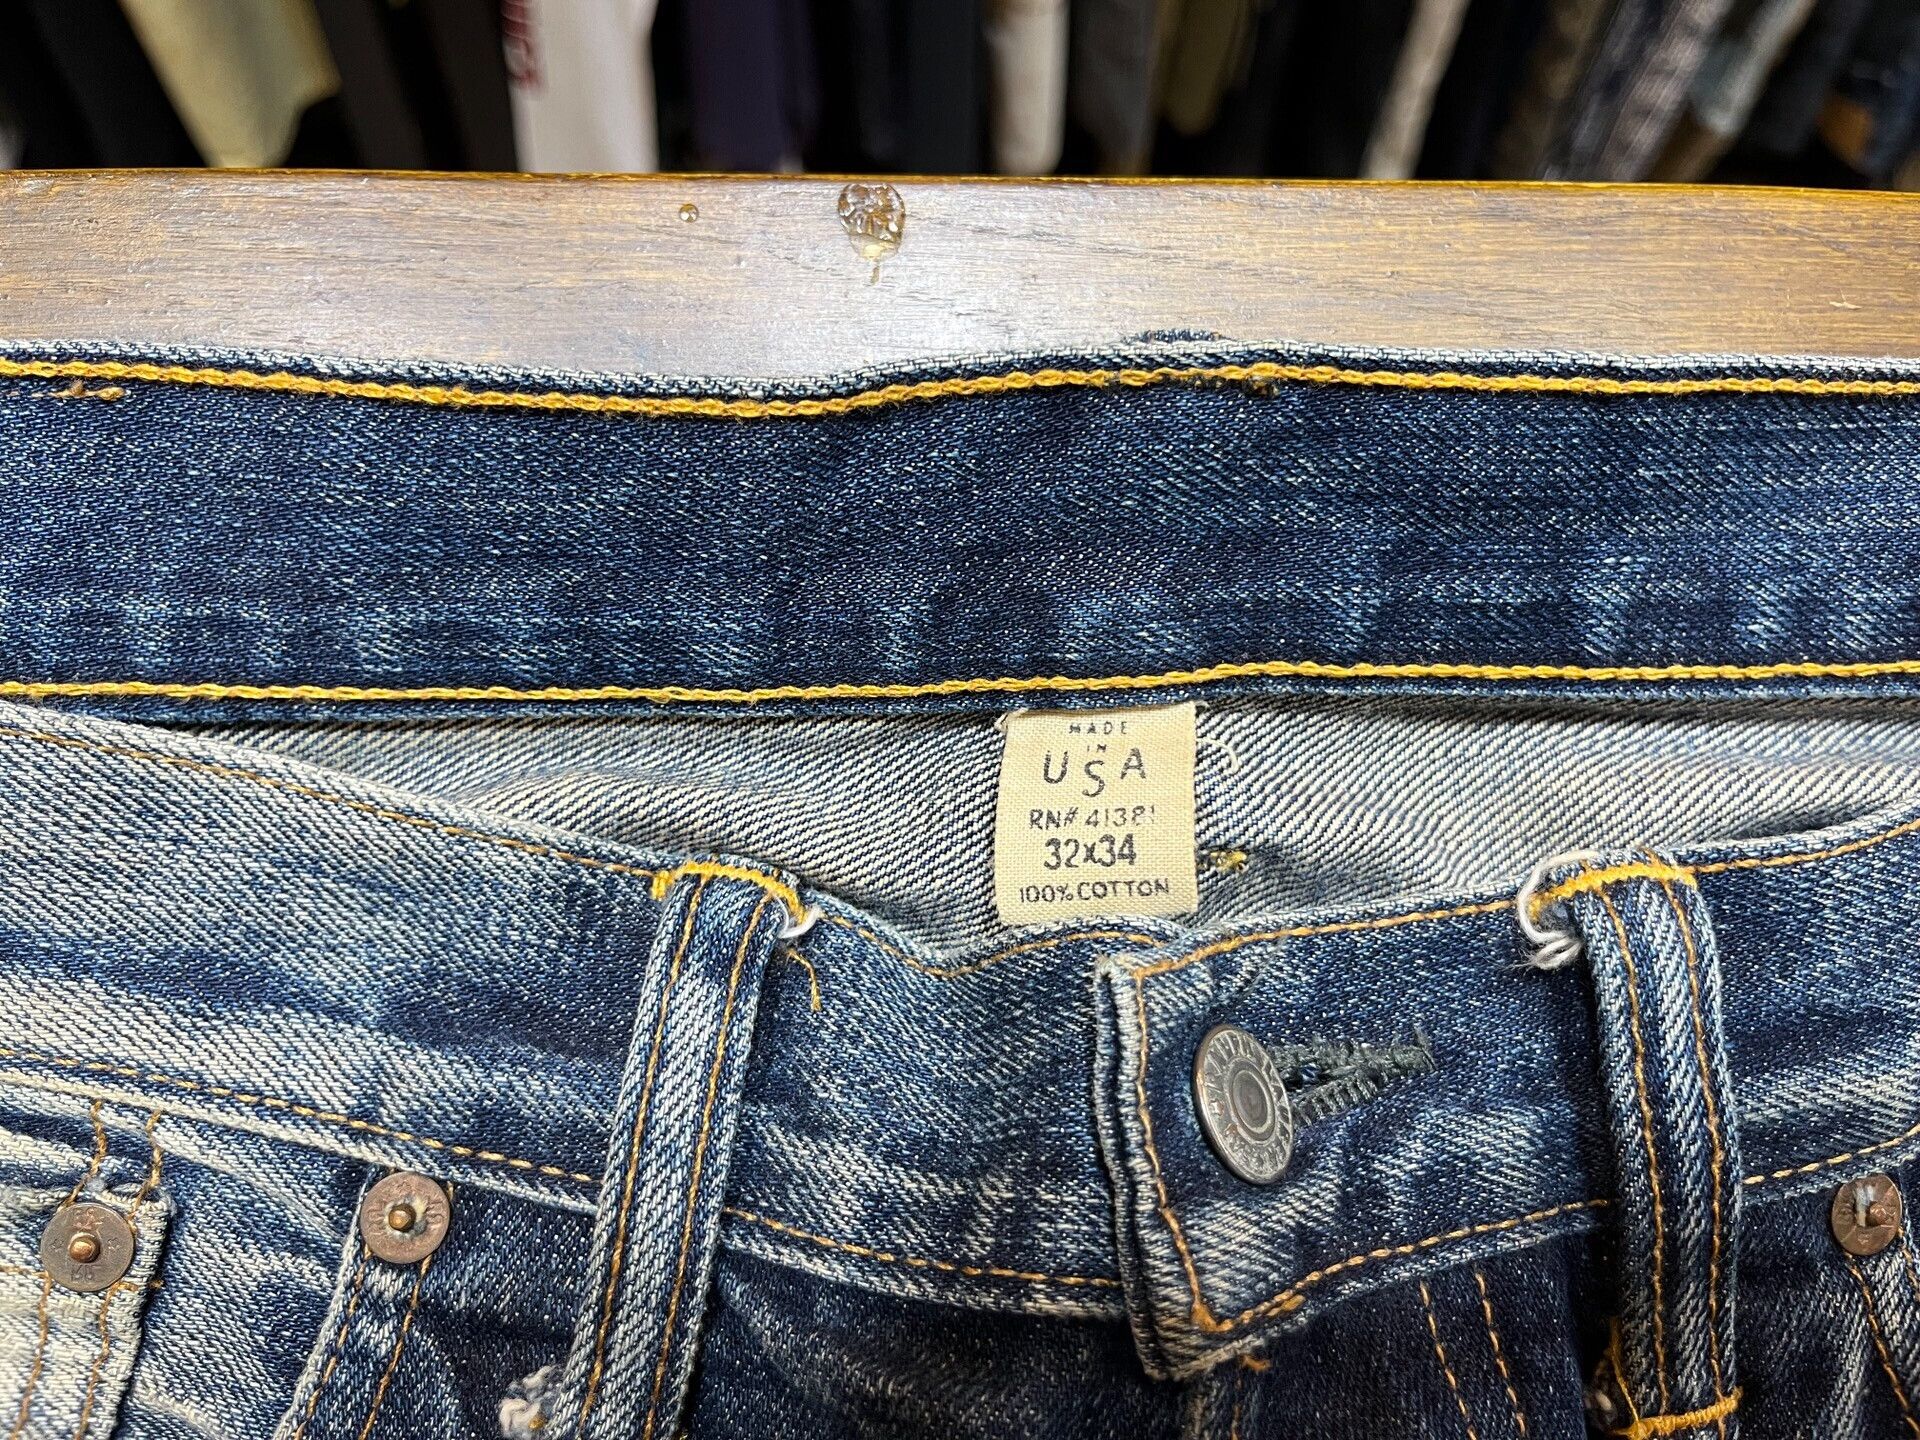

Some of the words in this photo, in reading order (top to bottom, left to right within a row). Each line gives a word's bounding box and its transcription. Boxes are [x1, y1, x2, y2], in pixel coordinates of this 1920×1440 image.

[1068, 721, 1128, 735] MADE
[1087, 744, 1107, 753] IN
[1043, 747, 1147, 798] USA
[1029, 806, 1079, 830] RN#
[1085, 804, 1156, 828] 41381
[1077, 877, 1170, 901] COTTON
